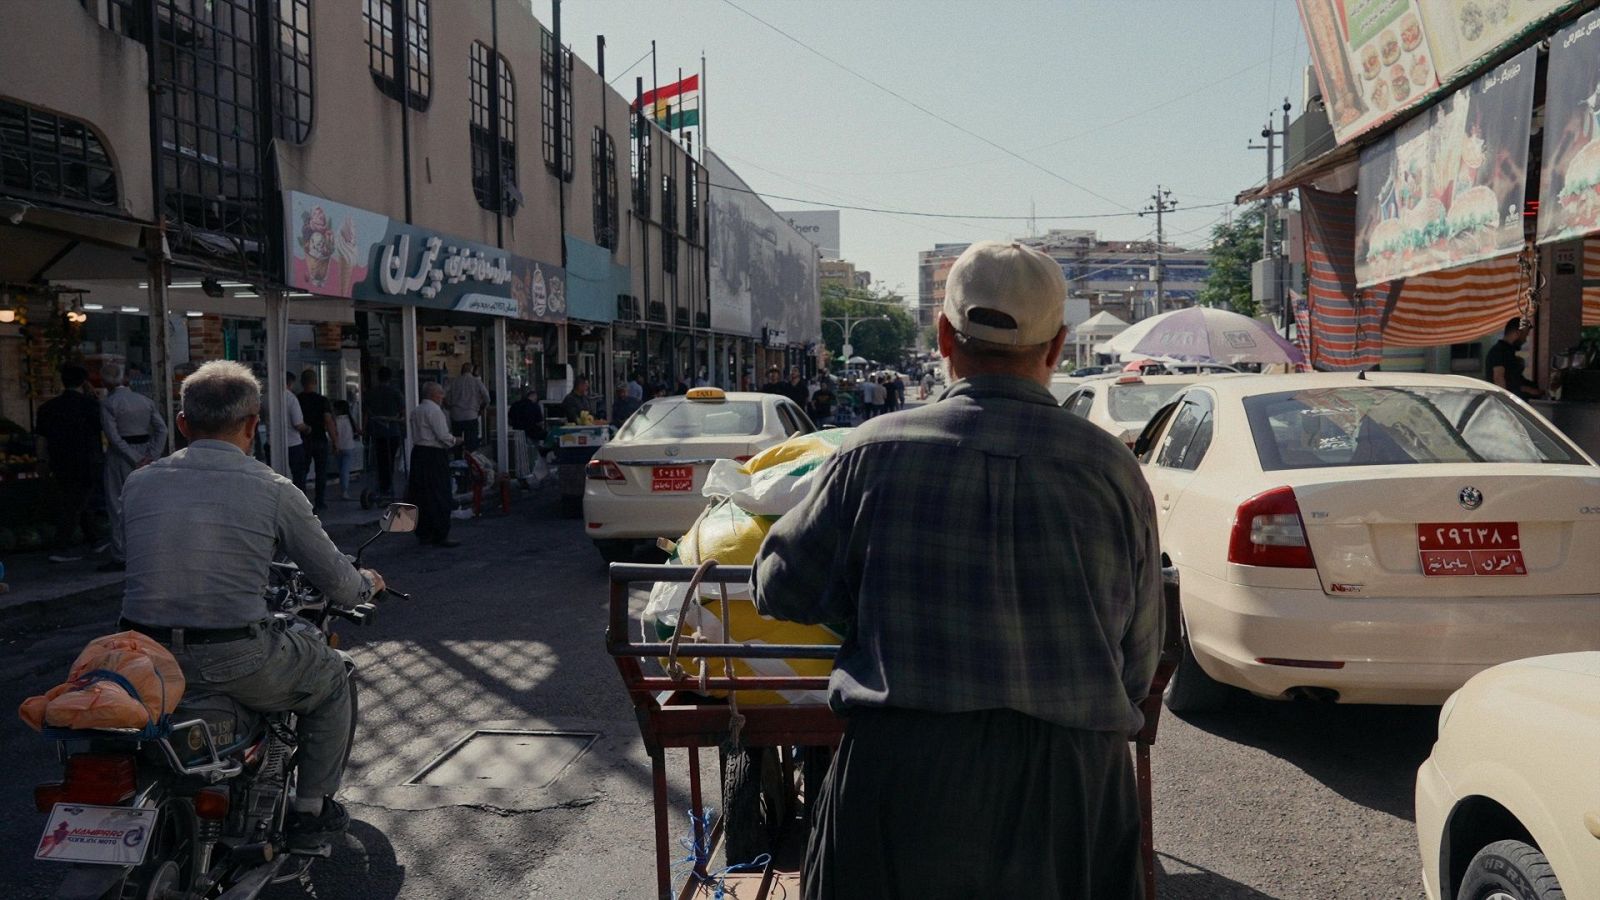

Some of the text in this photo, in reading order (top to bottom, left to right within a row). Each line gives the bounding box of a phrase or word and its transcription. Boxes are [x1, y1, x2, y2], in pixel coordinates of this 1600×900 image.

[1436, 528, 1502, 545] ٢٩٦٣٨
[1428, 555, 1516, 572] العراق سليمانية
[1485, 858, 1505, 871] HP
